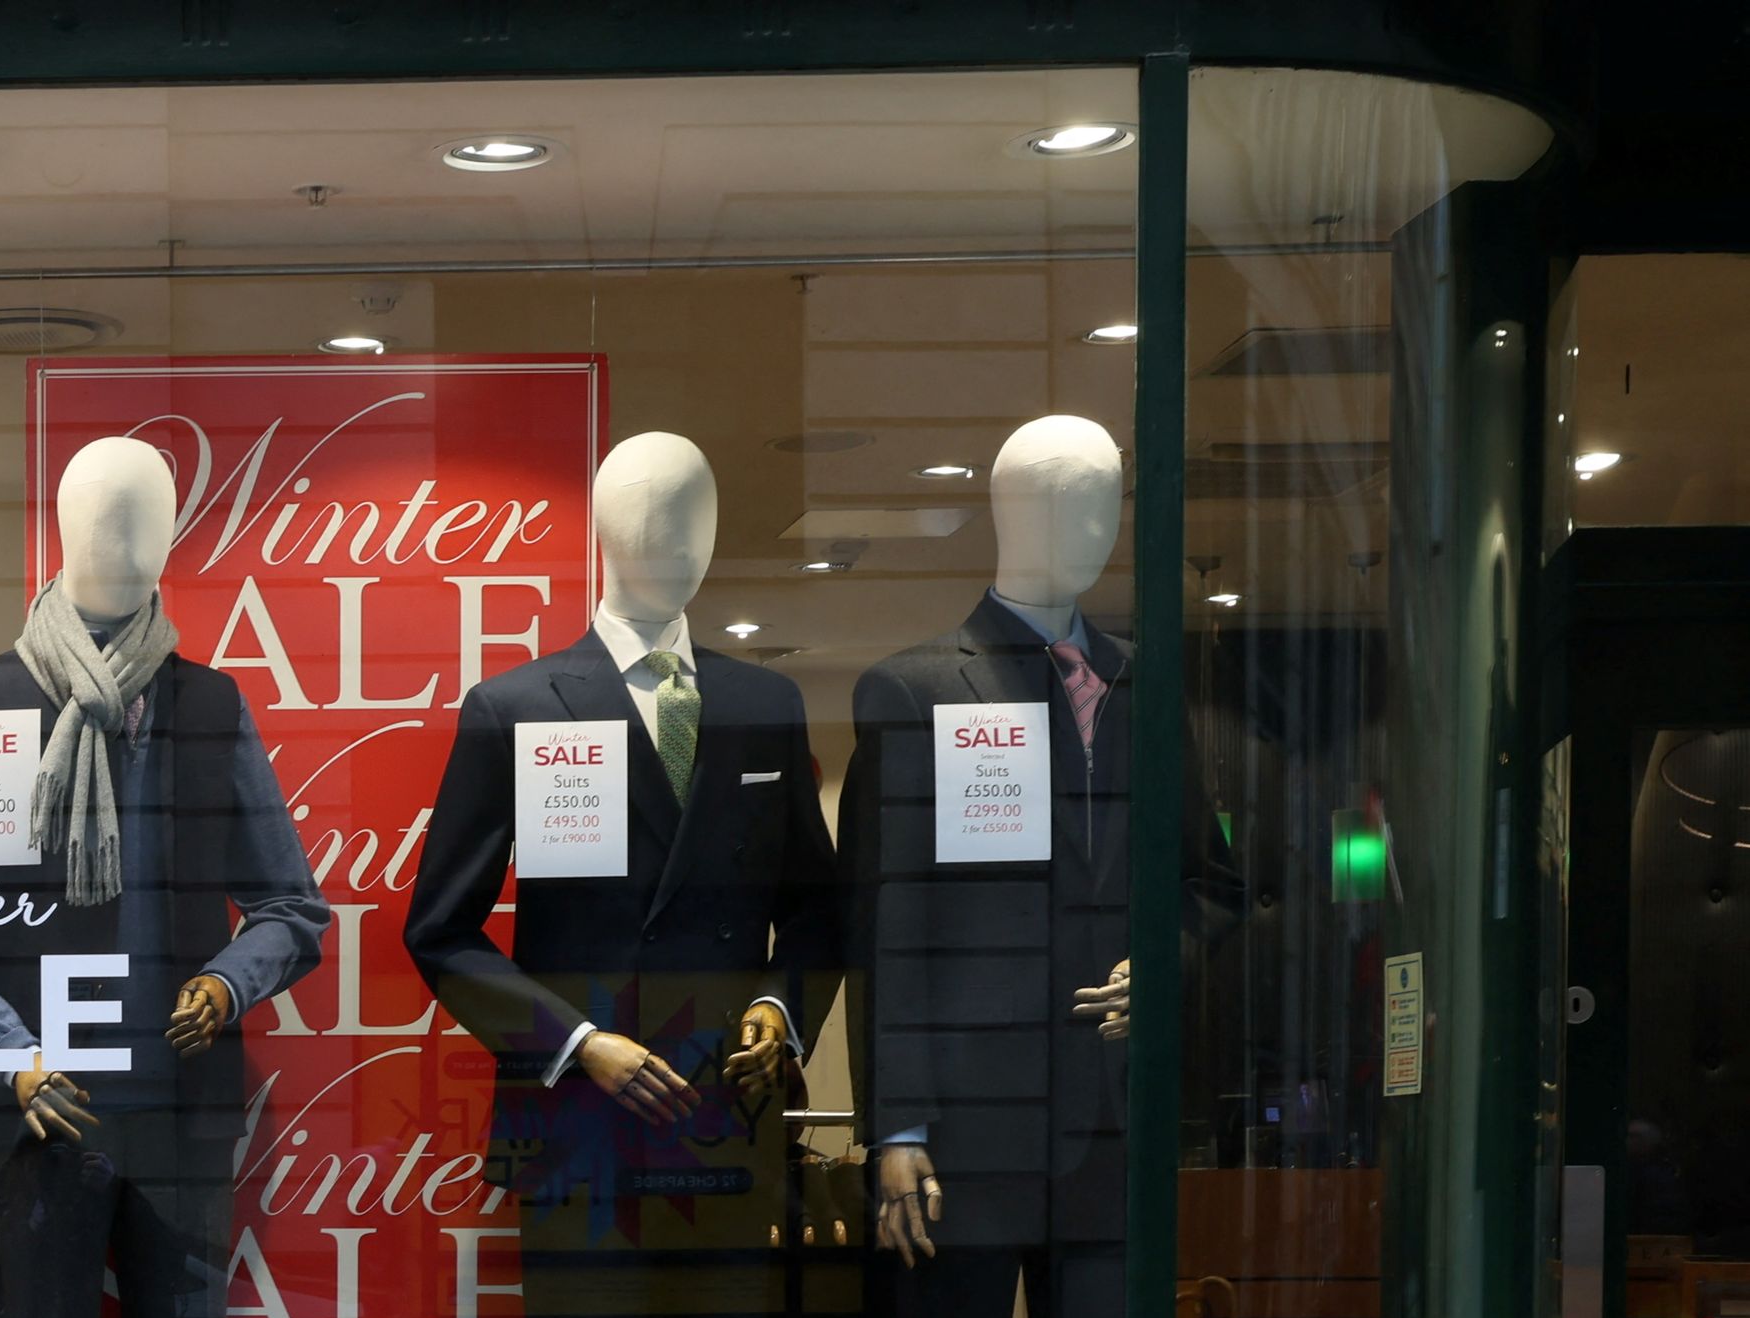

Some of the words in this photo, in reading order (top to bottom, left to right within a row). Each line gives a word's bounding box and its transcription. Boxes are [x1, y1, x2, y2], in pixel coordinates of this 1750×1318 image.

[124, 392, 552, 575] Winter
[209, 576, 551, 710] ALE
[969, 713, 1012, 727] Winter
[548, 731, 591, 746] Winter
[955, 727, 1026, 748] SALE
[534, 745, 604, 766] SALE
[976, 765, 1009, 777] Suits
[554, 774, 590, 788] Suits
[965, 784, 1021, 798] £550.00
[545, 795, 600, 808] £550.00
[964, 804, 1021, 817] £299.00
[544, 815, 600, 828] £495.00
[983, 823, 1023, 832] £550.00
[562, 834, 601, 843] £900.00
[233, 1046, 509, 1218] inte
